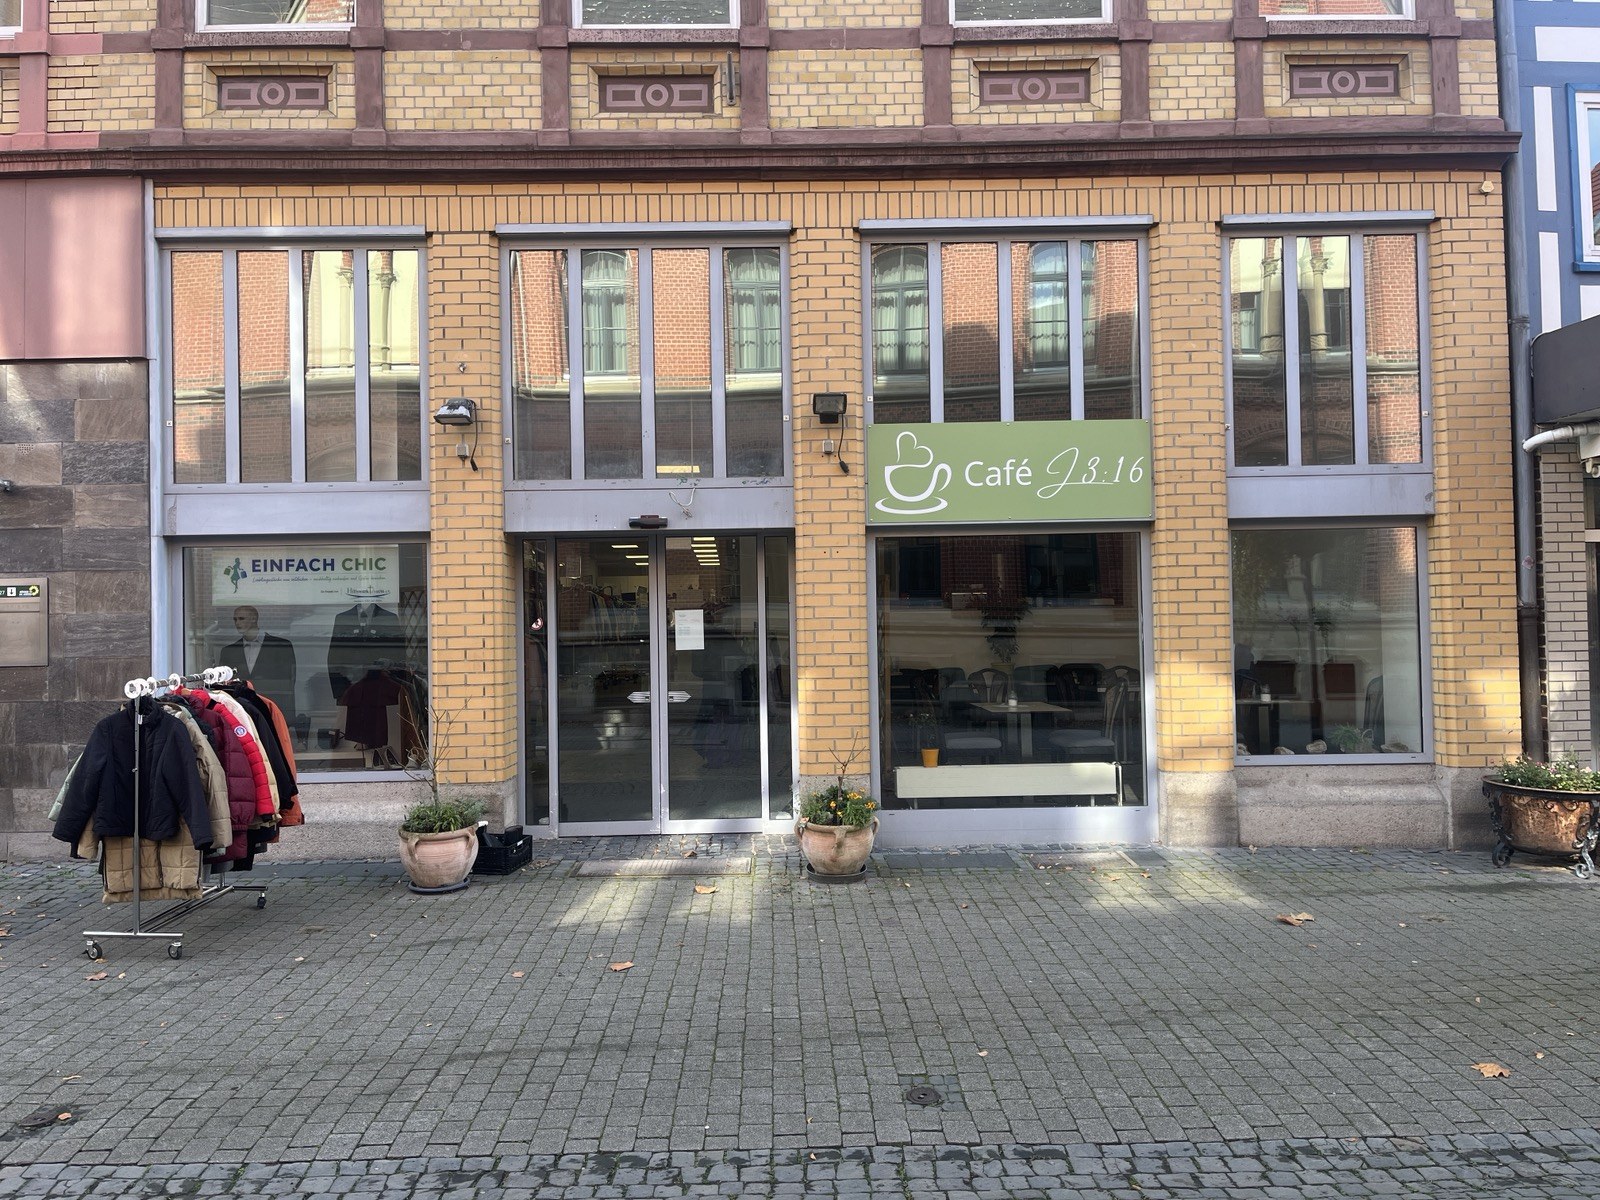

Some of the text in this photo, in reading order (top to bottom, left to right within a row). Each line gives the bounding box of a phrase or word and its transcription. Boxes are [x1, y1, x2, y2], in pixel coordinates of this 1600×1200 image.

[964, 458, 1033, 487] Café
[251, 556, 387, 573] EINFACH CHIC
